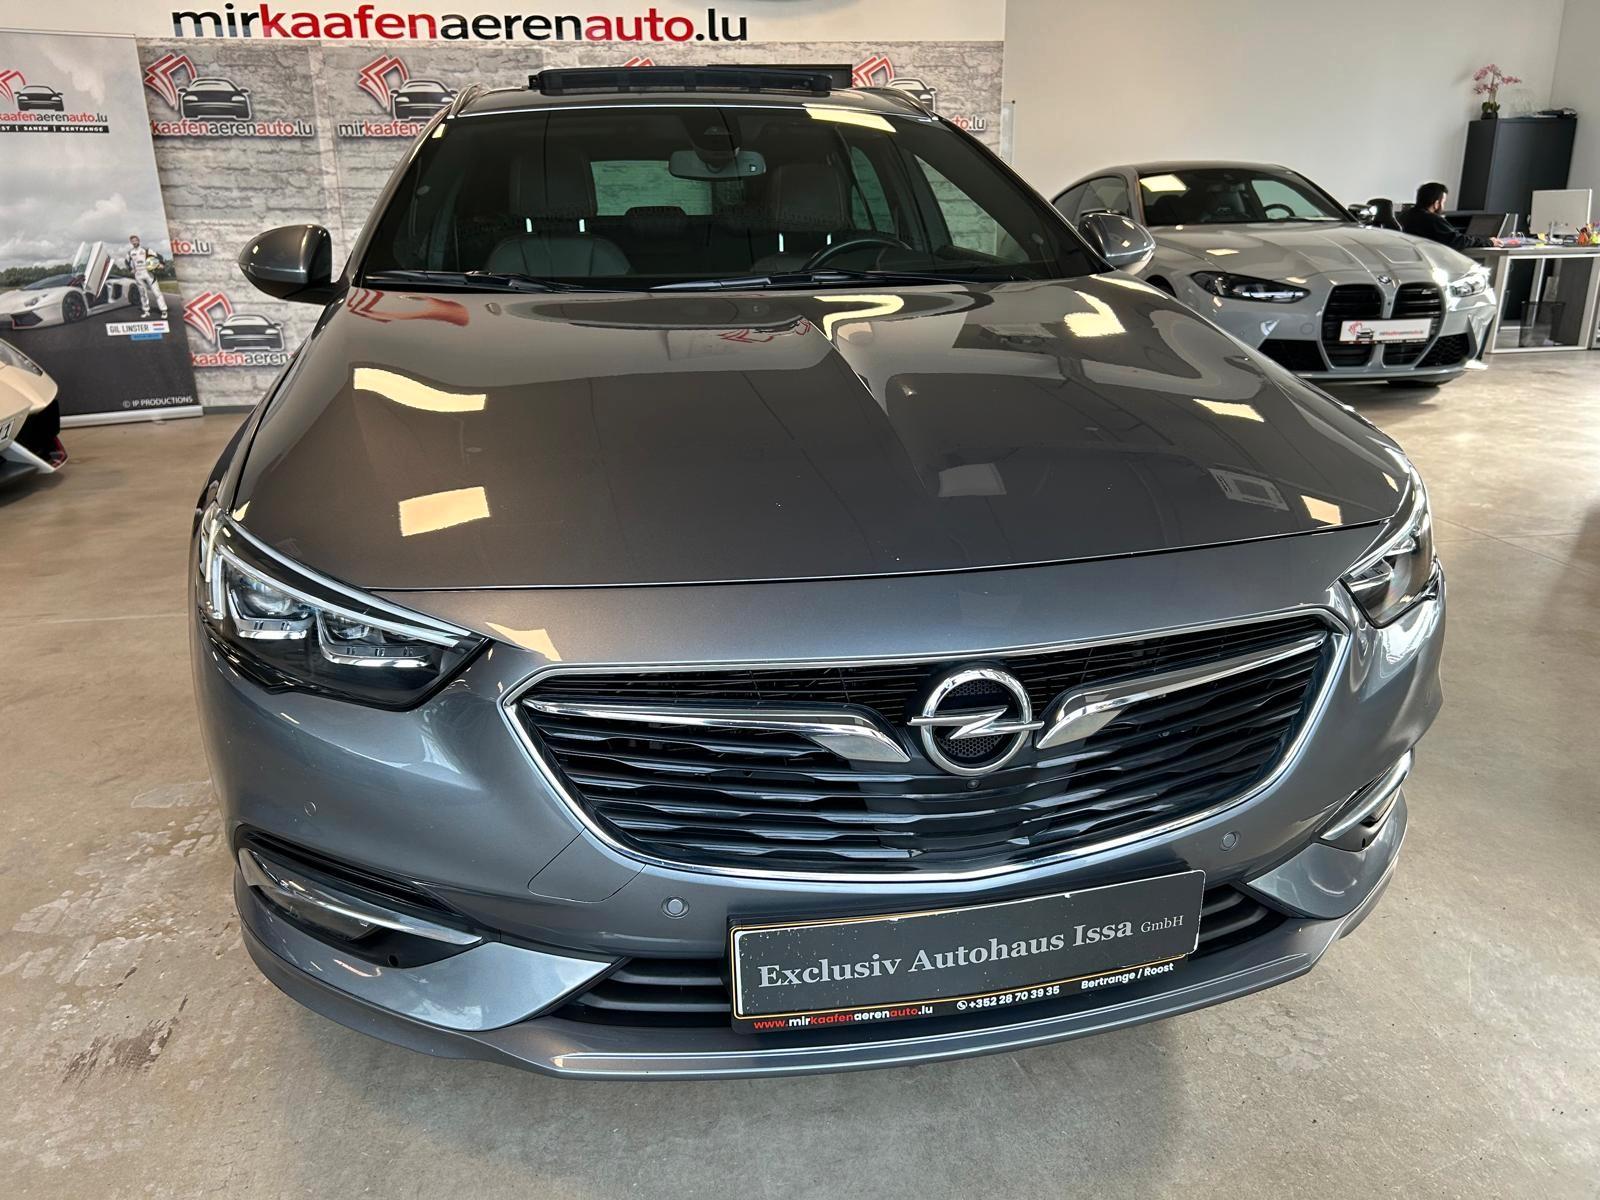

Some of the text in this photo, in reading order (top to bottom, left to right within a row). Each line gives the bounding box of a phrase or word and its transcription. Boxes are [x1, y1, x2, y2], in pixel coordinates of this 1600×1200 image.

[172, 3, 747, 41] mirkaafenaerenauto.lu
[109, 324, 149, 334] GIL LINSTER
[141, 396, 193, 406] PRODUCTIONS
[758, 915, 1184, 988] Exclusiv Autohaus Issa GmbH
[753, 1005, 933, 1030] www.mirkaafenaerenauto.lu
[968, 996, 996, 1009] +352
[998, 994, 1012, 1005] 28
[1014, 990, 1029, 1002] 70
[1030, 988, 1044, 999] 39
[1046, 985, 1060, 996] 35
[1081, 971, 1136, 990] Bertrange
[1144, 962, 1174, 977] Roost
